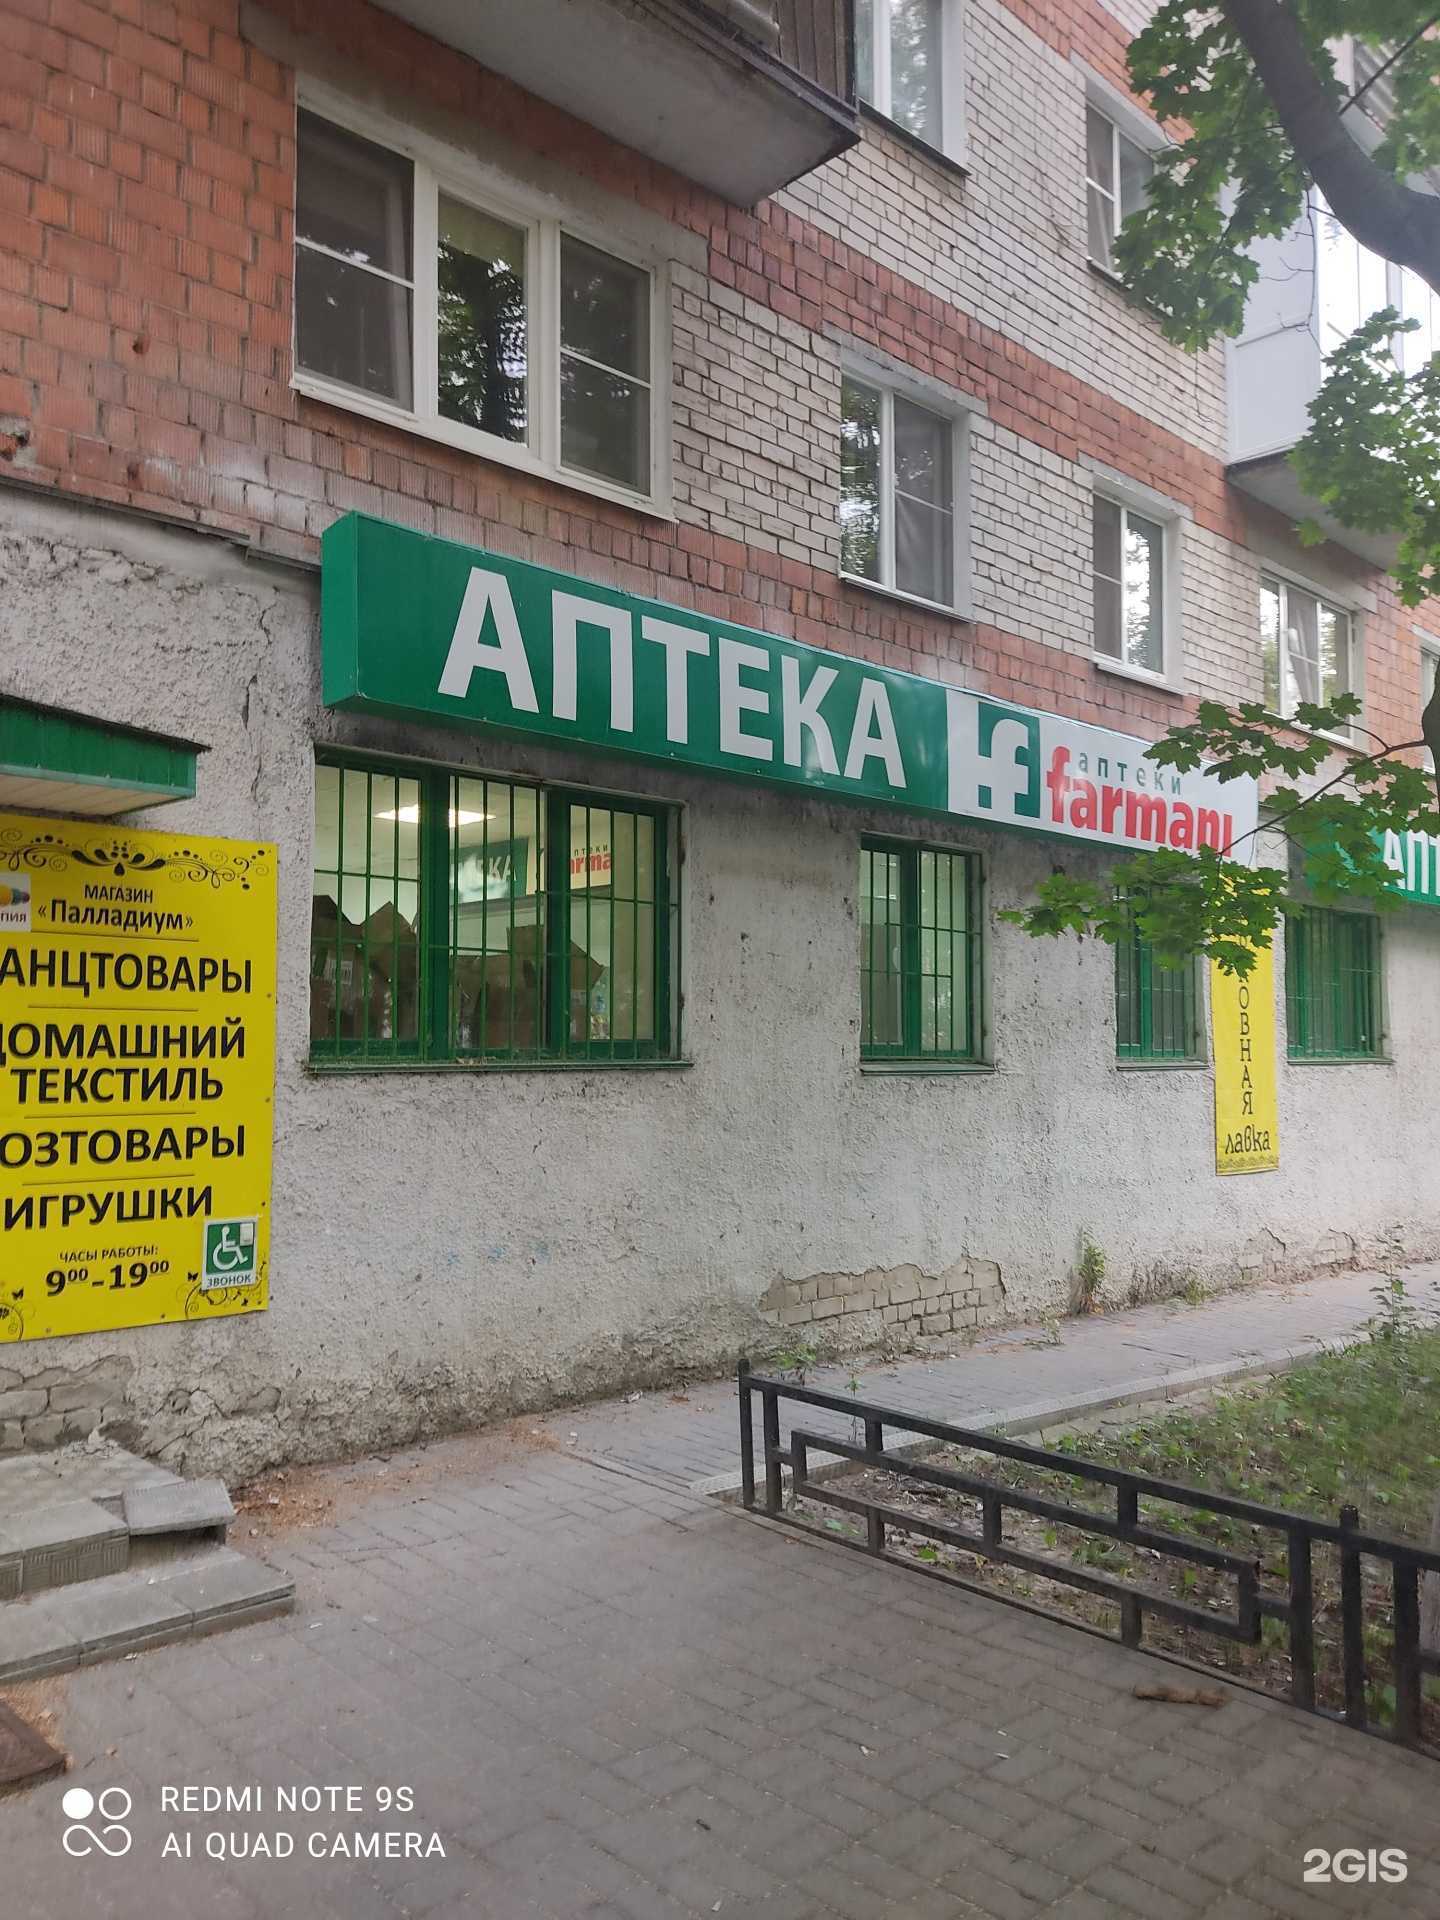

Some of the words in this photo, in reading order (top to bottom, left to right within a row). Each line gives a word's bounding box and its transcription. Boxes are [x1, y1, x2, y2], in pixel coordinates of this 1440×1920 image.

[437, 566, 907, 789] АПТЕКА
[1078, 750, 1182, 796] аптеки
[84, 884, 153, 904] МАГАЗИН
[0, 1017, 245, 1066] ОМАШНИЙ
[10, 1068, 223, 1105] ТЕКСТИЛЬ
[4, 1186, 213, 1232] ИГРУШКИ
[60, 1249, 98, 1263] ЧАСЫ
[101, 1245, 159, 1260] РАБОТЫ:
[207, 1274, 252, 1289] ЗВОНОК
